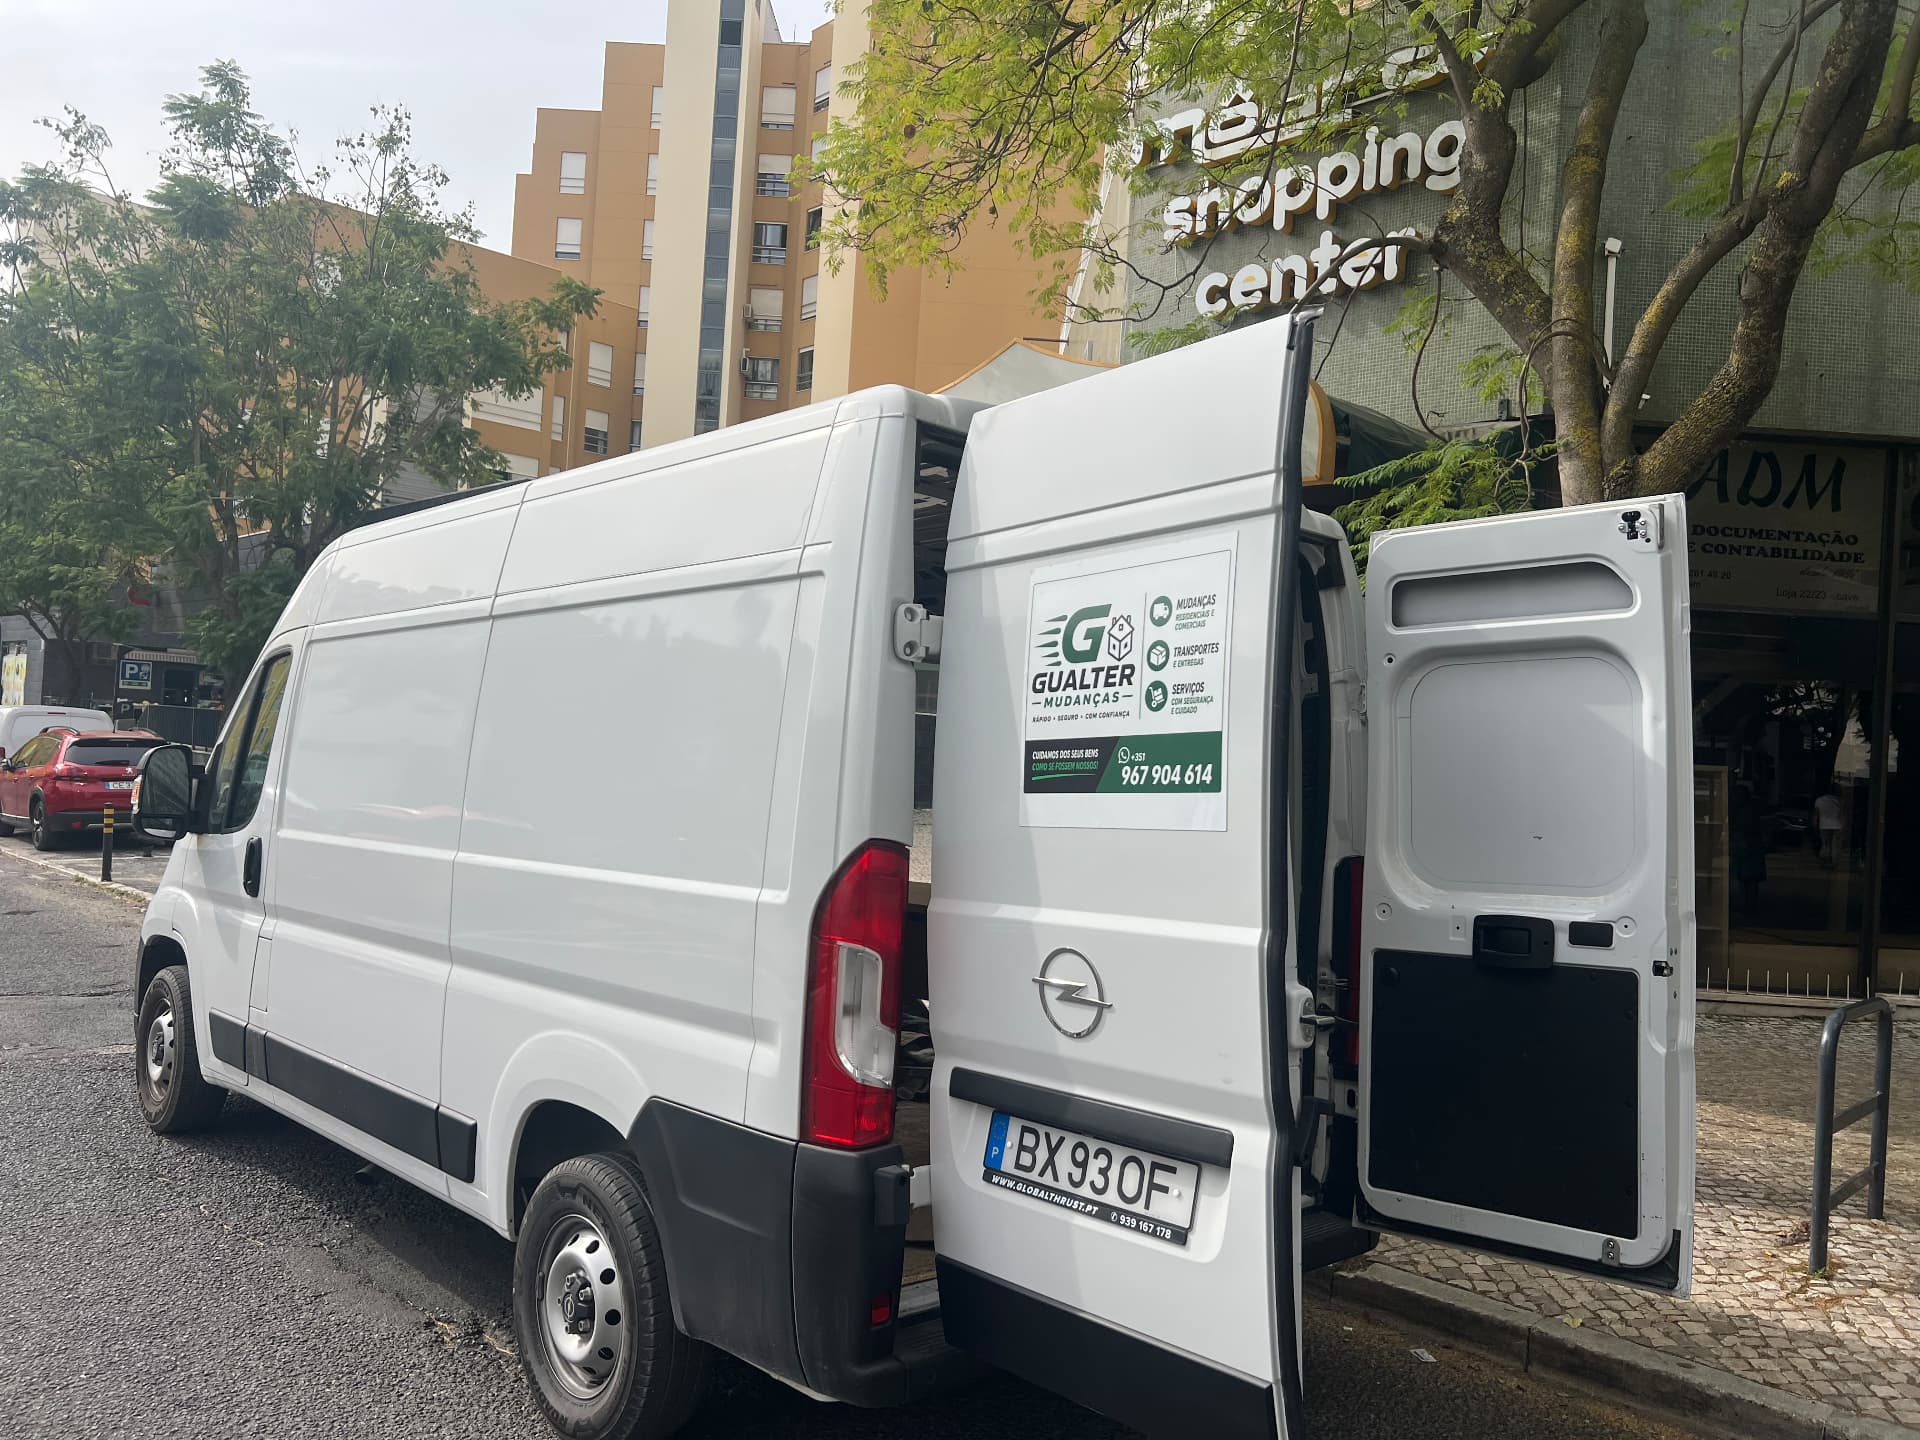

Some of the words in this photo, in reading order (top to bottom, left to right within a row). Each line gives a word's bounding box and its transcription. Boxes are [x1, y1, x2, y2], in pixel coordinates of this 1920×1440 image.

[1163, 120, 1466, 243] shopping
[1195, 227, 1423, 316] center
[1686, 447, 1847, 512] ADM
[1691, 524, 1859, 547] DOCUMENTAÇÃO
[1700, 542, 1865, 564] CONTABILIDADE
[1176, 594, 1216, 610] MUDANÇAS
[1174, 642, 1219, 657] TRANSPORTES
[125, 663, 139, 679] P
[1032, 664, 1136, 693] GUALTER
[1172, 682, 1205, 696] SERVIÇOS
[1044, 691, 1120, 708] MUDANÇAS
[1085, 712, 1098, 720] COM
[1032, 751, 1059, 760] CUIDAMOS
[1060, 750, 1071, 759] DOS
[1071, 749, 1084, 758] SEUS
[1084, 748, 1099, 758] BENS
[1131, 752, 1146, 762] +351
[1121, 765, 1149, 785] 967
[1151, 764, 1182, 785] 904
[1184, 763, 1213, 785] 614
[991, 1146, 999, 1158] P
[991, 1174, 1099, 1215] WWW.GLOBALTHRUST.PT
[1120, 1214, 1137, 1228] 939
[1139, 1220, 1154, 1234] 167
[1156, 1226, 1172, 1239] 178
